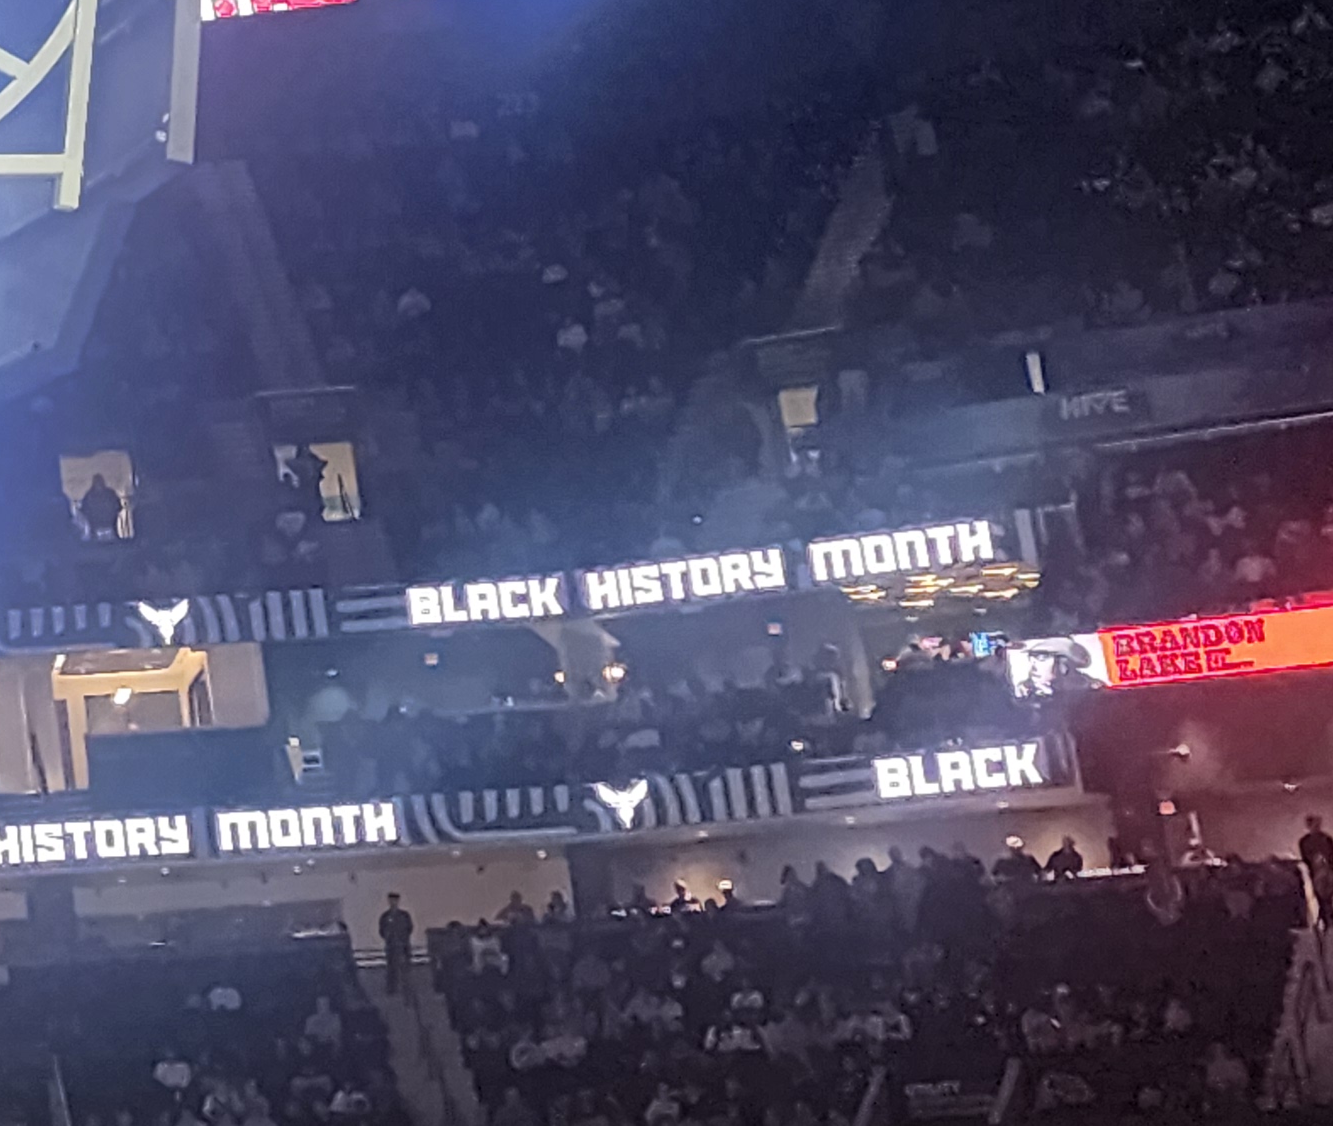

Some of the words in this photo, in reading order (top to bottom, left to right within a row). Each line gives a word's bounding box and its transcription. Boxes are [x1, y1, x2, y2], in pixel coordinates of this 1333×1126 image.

[405, 577, 564, 625] BLACK
[585, 548, 786, 610] HISTORY
[808, 520, 994, 580] MONTH
[1113, 618, 1265, 658] BRANDON
[873, 743, 1043, 799] BLACK
[216, 803, 397, 851] MONTH
